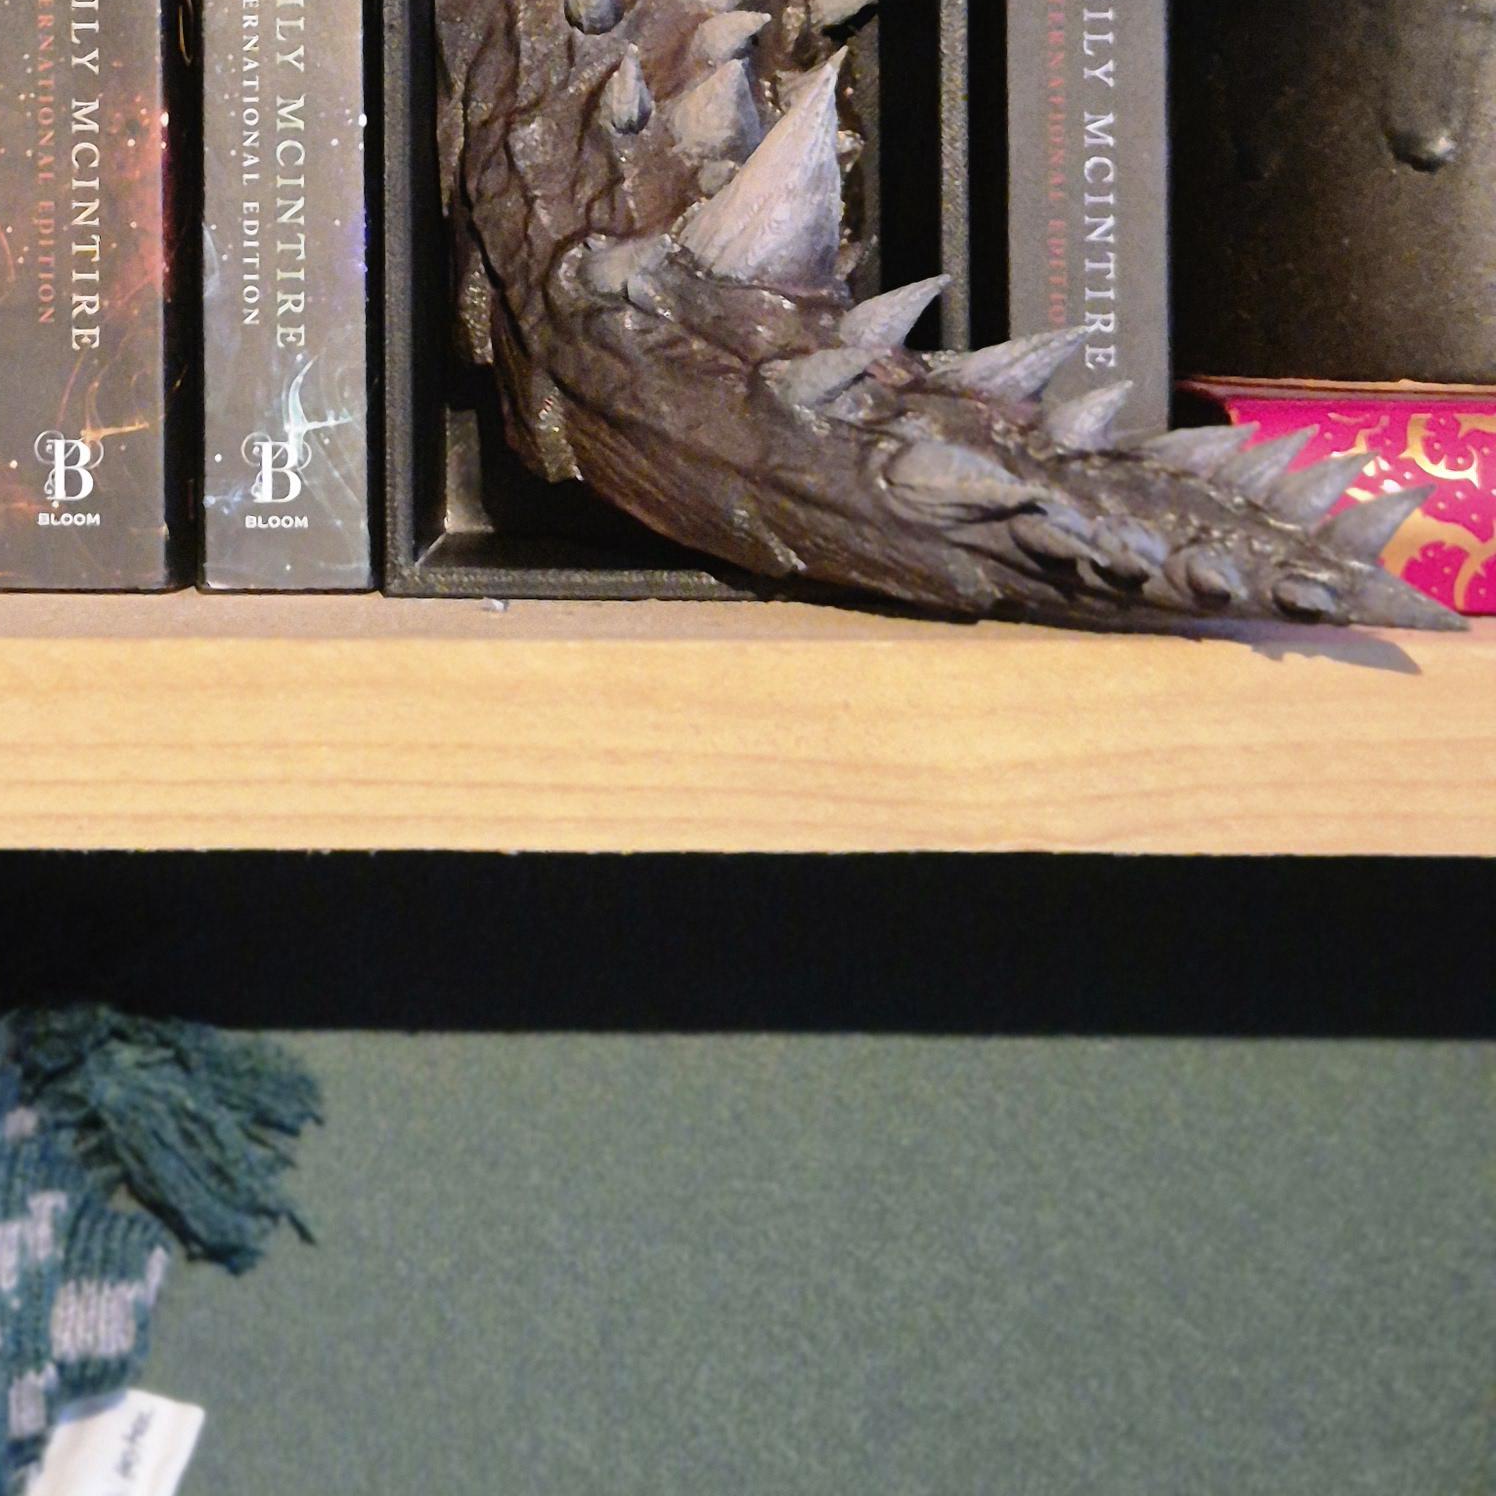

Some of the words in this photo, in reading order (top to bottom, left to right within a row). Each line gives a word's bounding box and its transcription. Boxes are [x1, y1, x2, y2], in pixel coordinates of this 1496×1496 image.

[38, 201, 55, 324] EDITION
[70, 98, 101, 351] MCINTIRE
[242, 201, 260, 326] EDITION
[275, 95, 306, 349] MCINTIRE
[1047, 219, 1067, 326] EDITIO
[1083, 110, 1116, 371] MCINTIRE
[37, 512, 101, 527] BLOOM
[245, 515, 309, 529] BLOOM
